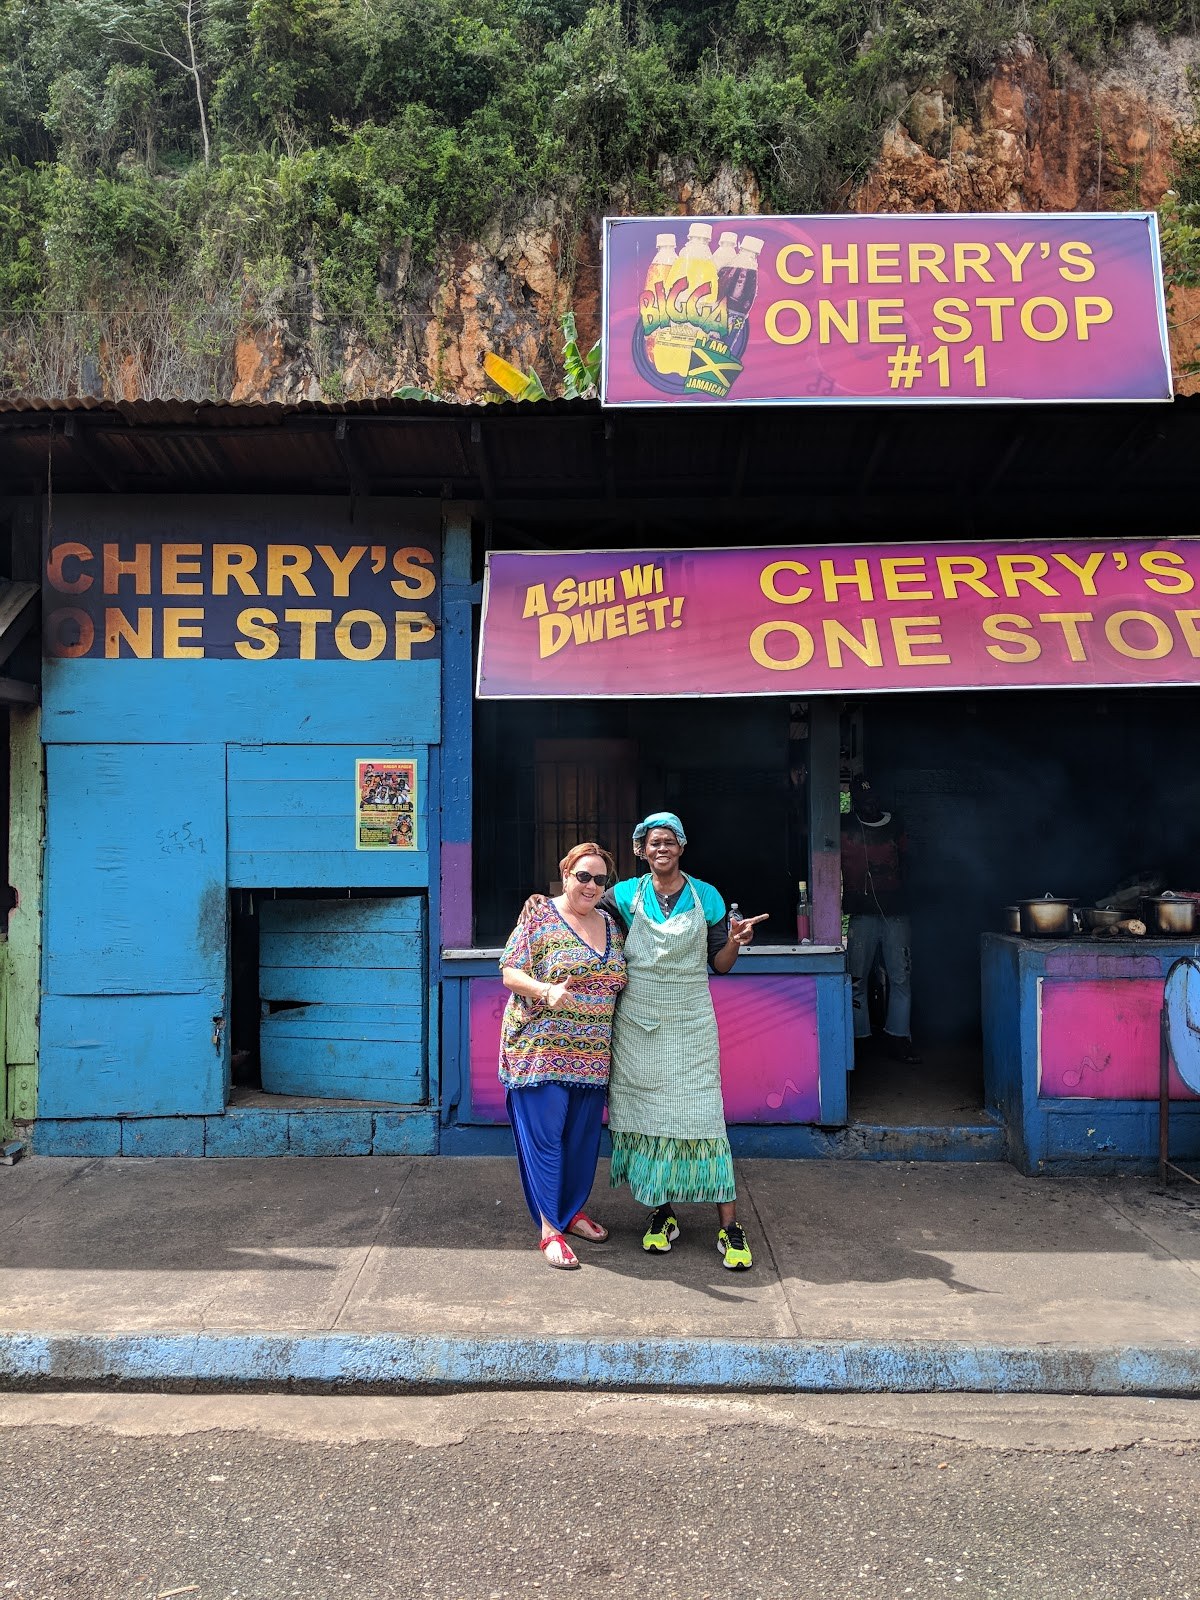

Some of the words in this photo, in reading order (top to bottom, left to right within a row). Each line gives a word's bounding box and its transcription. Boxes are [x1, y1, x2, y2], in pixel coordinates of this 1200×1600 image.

[775, 241, 1096, 285] CHERRY’S
[639, 276, 729, 336] BIGGA
[764, 298, 908, 345] ONE
[932, 296, 1114, 342] STOP
[709, 340, 728, 355] AM
[887, 345, 987, 389] #11
[686, 378, 728, 397] JAMAICAN
[46, 542, 437, 600] CHERRY’S
[759, 550, 1195, 605] CHERRY’S
[522, 583, 550, 619] A
[47, 606, 205, 659] ONE
[234, 607, 436, 661] STOP
[749, 616, 951, 671] ONE
